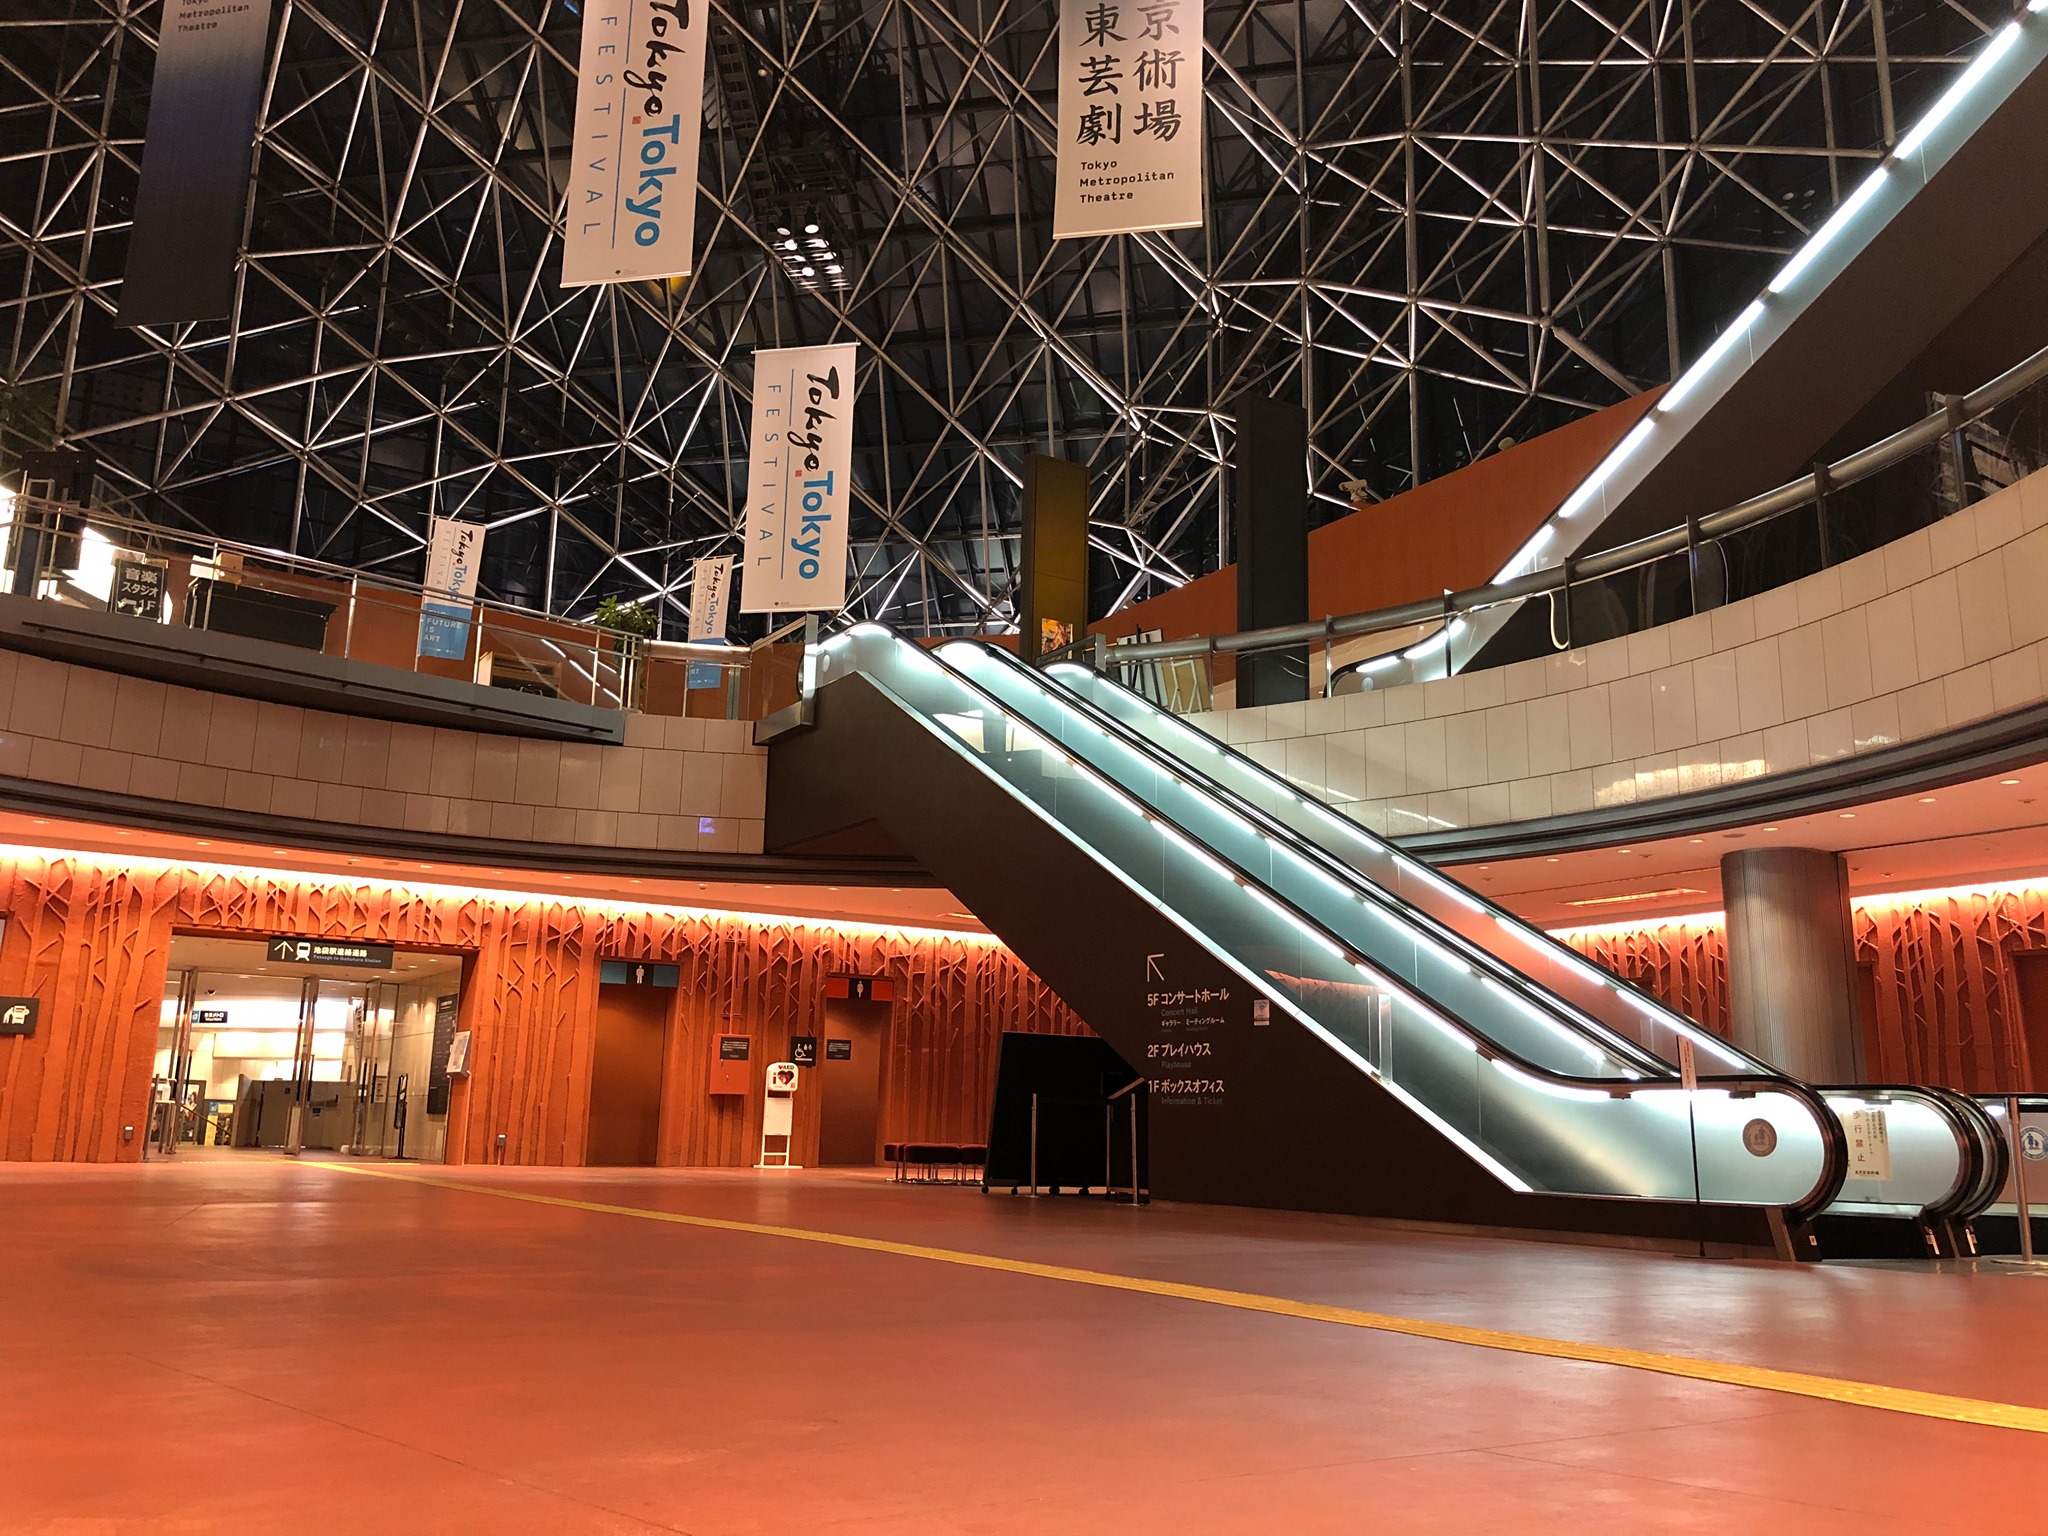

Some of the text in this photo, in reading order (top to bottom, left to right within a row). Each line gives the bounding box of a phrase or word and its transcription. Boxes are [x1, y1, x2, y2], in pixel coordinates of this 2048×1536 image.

[178, 4, 250, 19] Metropolitan
[178, 21, 218, 33] Theatre
[583, 16, 618, 235] FESTIVAL
[623, 0, 690, 247] Tokyo Tokyo
[1081, 160, 1118, 171] Tokyo
[1079, 171, 1175, 187] Metropolitan
[1080, 191, 1134, 204] Theatre
[787, 366, 840, 472] Tokyo
[757, 384, 782, 566] FESTIVAL
[791, 471, 834, 580] Tokyo
[451, 529, 474, 565] Tokyo
[436, 530, 451, 587] FESTIVA
[125, 567, 158, 584] 音楽
[121, 581, 159, 598] スタジオ
[704, 563, 724, 634] Tokyo Tokyo
[427, 617, 463, 629] FUTURE
[423, 634, 441, 643] ART
[1147, 988, 1230, 1006] 5F コンサートホール
[1161, 1007, 1199, 1016] Concert Hall
[1147, 1042, 1212, 1057] 2F プレイハウス
[1161, 1061, 1192, 1070] Playhouse
[1147, 1079, 1225, 1094] 1F ボックスオフィス
[1161, 1096, 1223, 1105] Information & Ticket
